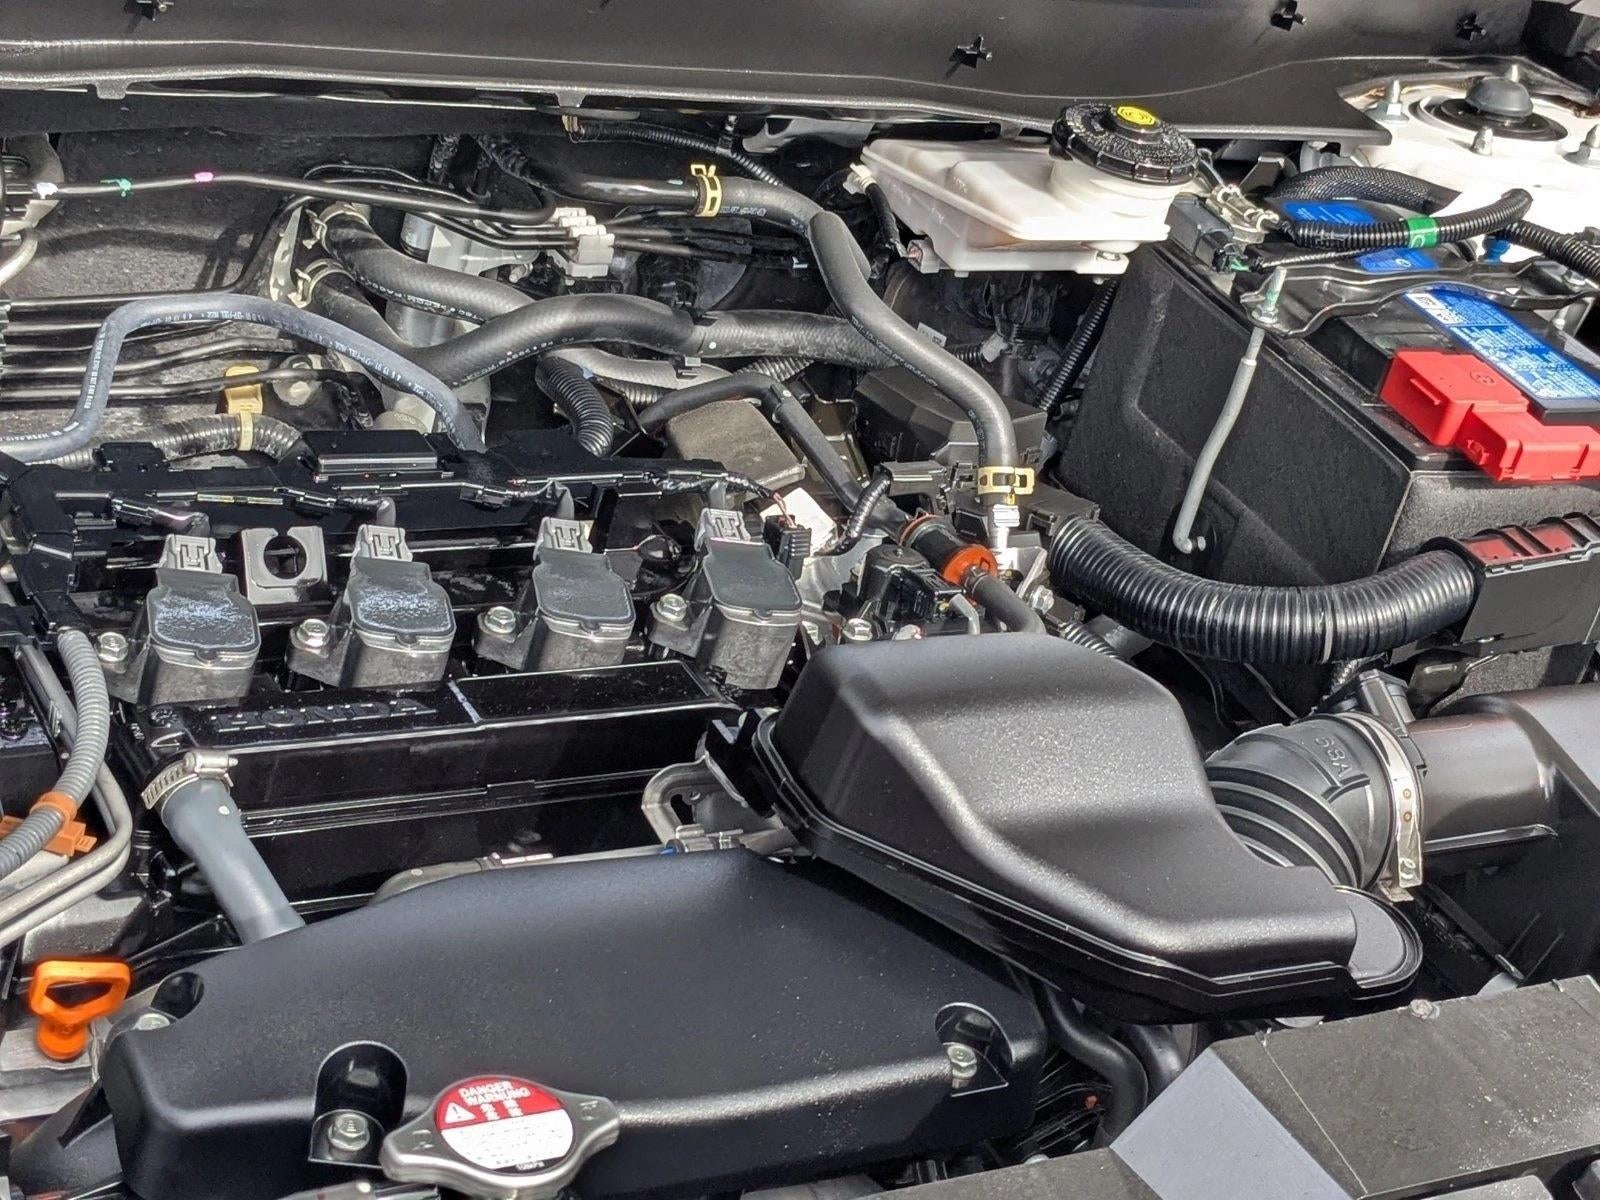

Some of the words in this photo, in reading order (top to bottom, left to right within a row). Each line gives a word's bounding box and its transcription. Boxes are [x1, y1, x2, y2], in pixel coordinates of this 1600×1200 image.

[211, 699, 438, 732] HONDA
[458, 1080, 513, 1098] DANGER
[464, 1087, 531, 1106] WARNING
